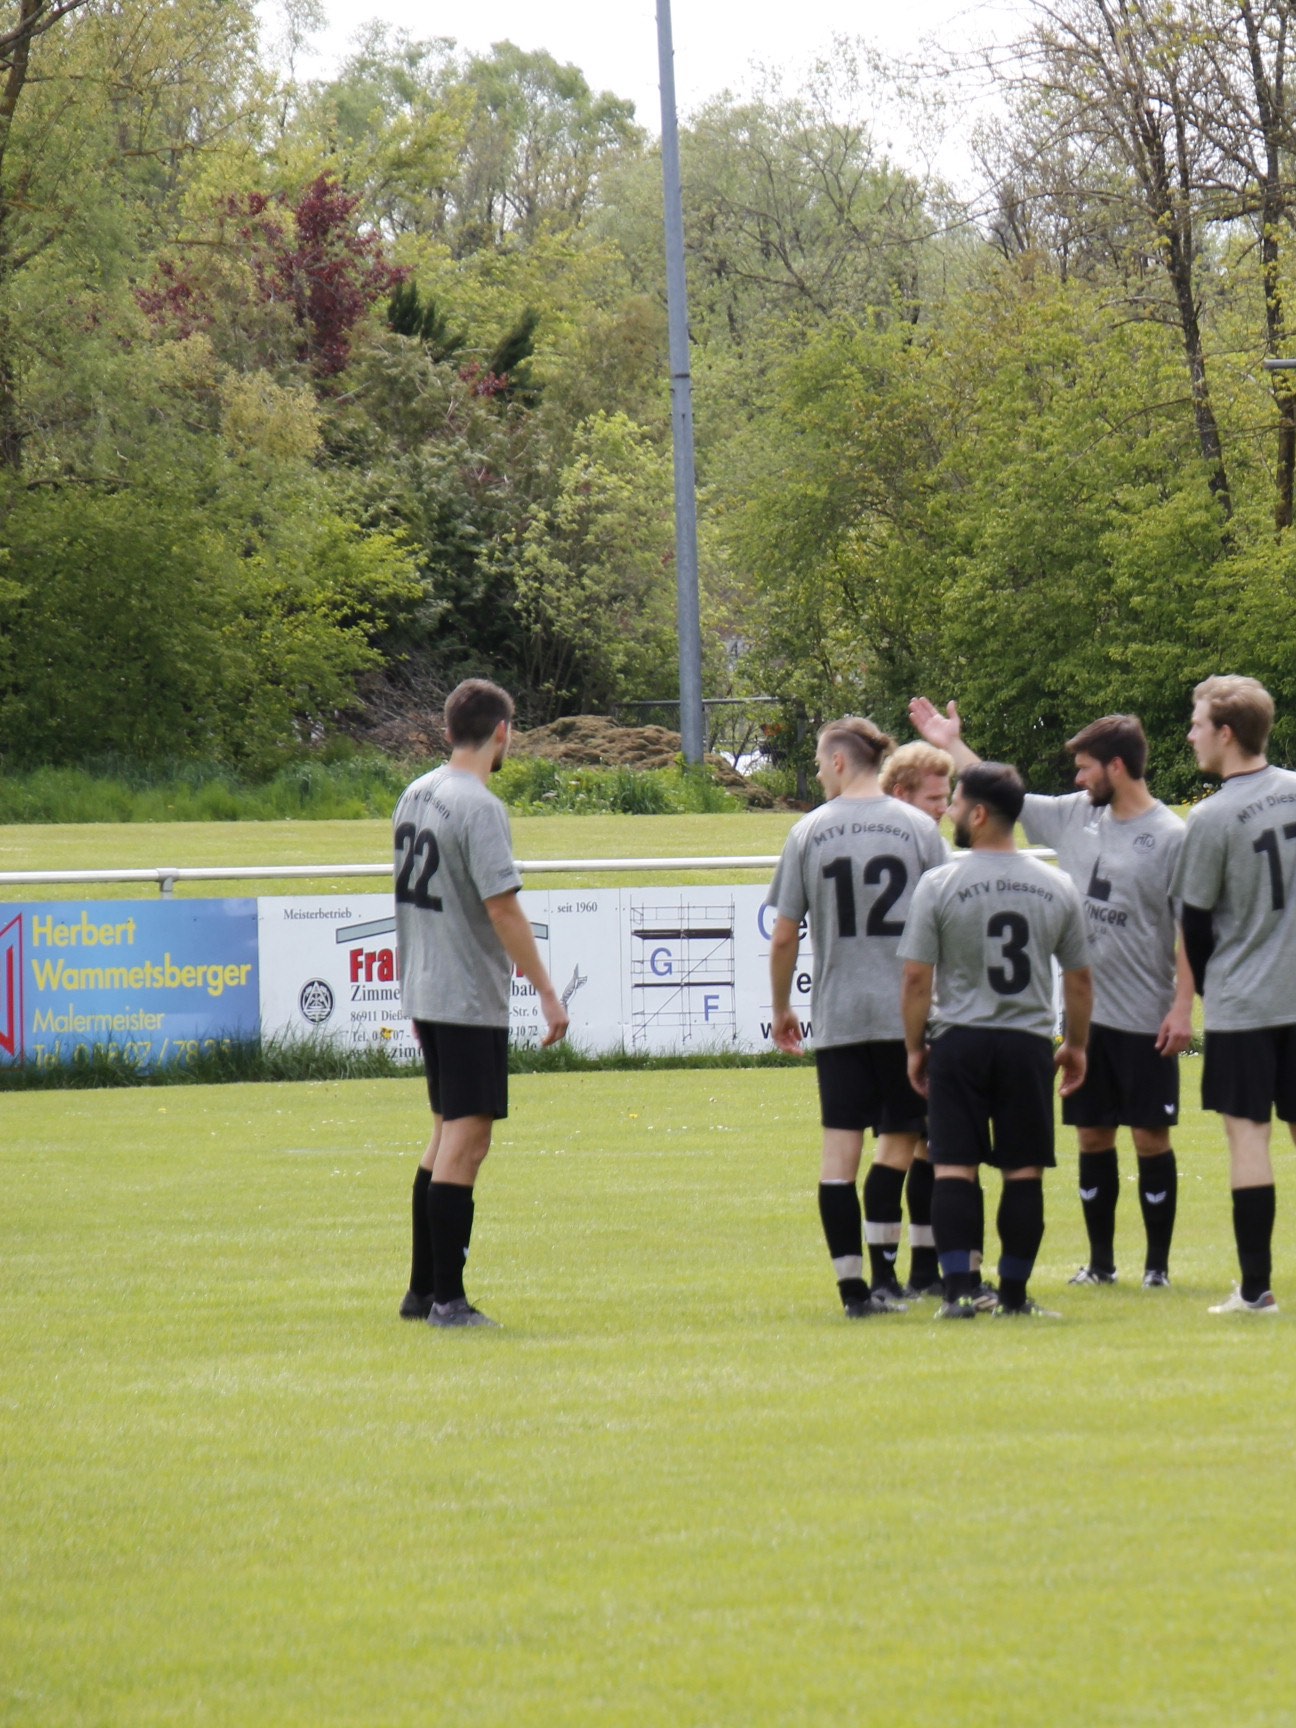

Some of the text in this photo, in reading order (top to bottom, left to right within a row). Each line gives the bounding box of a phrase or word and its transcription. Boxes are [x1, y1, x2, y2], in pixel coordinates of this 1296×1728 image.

[1237, 802, 1264, 824] MTV
[814, 822, 911, 847] MTV Diessen
[394, 821, 443, 912] 22
[822, 854, 908, 938] 12
[958, 878, 1054, 903] MTV Diessen
[283, 901, 598, 920] Meisterbetrieb seit 1960
[32, 911, 136, 947] Herbert
[349, 947, 400, 982] Fra
[650, 946, 673, 976] G
[987, 910, 1032, 995] 3
[32, 953, 252, 996] Wammetsberger
[33, 1003, 165, 1034] Malermeister
[350, 1010, 377, 1022] 86911
[532, 1005, 538, 1017] 6
[704, 994, 719, 1021] F
[528, 1025, 538, 1036] 72
